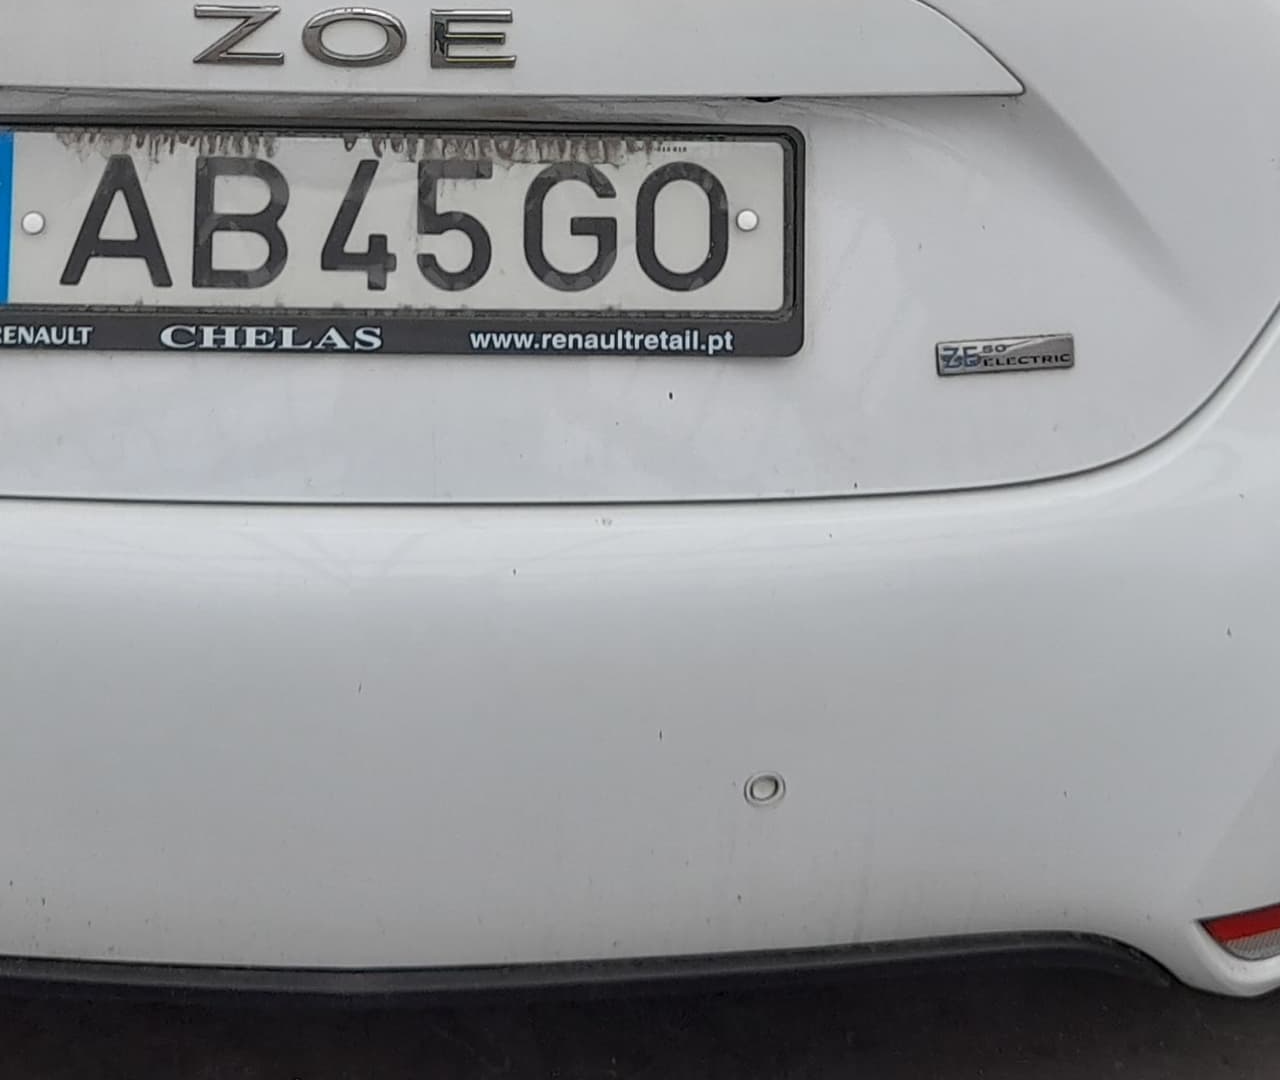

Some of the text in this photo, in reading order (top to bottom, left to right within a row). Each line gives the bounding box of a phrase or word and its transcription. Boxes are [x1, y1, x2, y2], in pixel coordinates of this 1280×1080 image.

[193, 4, 517, 69] ZOE
[160, 324, 384, 351] CHELAS
[470, 328, 734, 355] www.renaultretail.pt
[983, 353, 1071, 367] ELECTRIC
